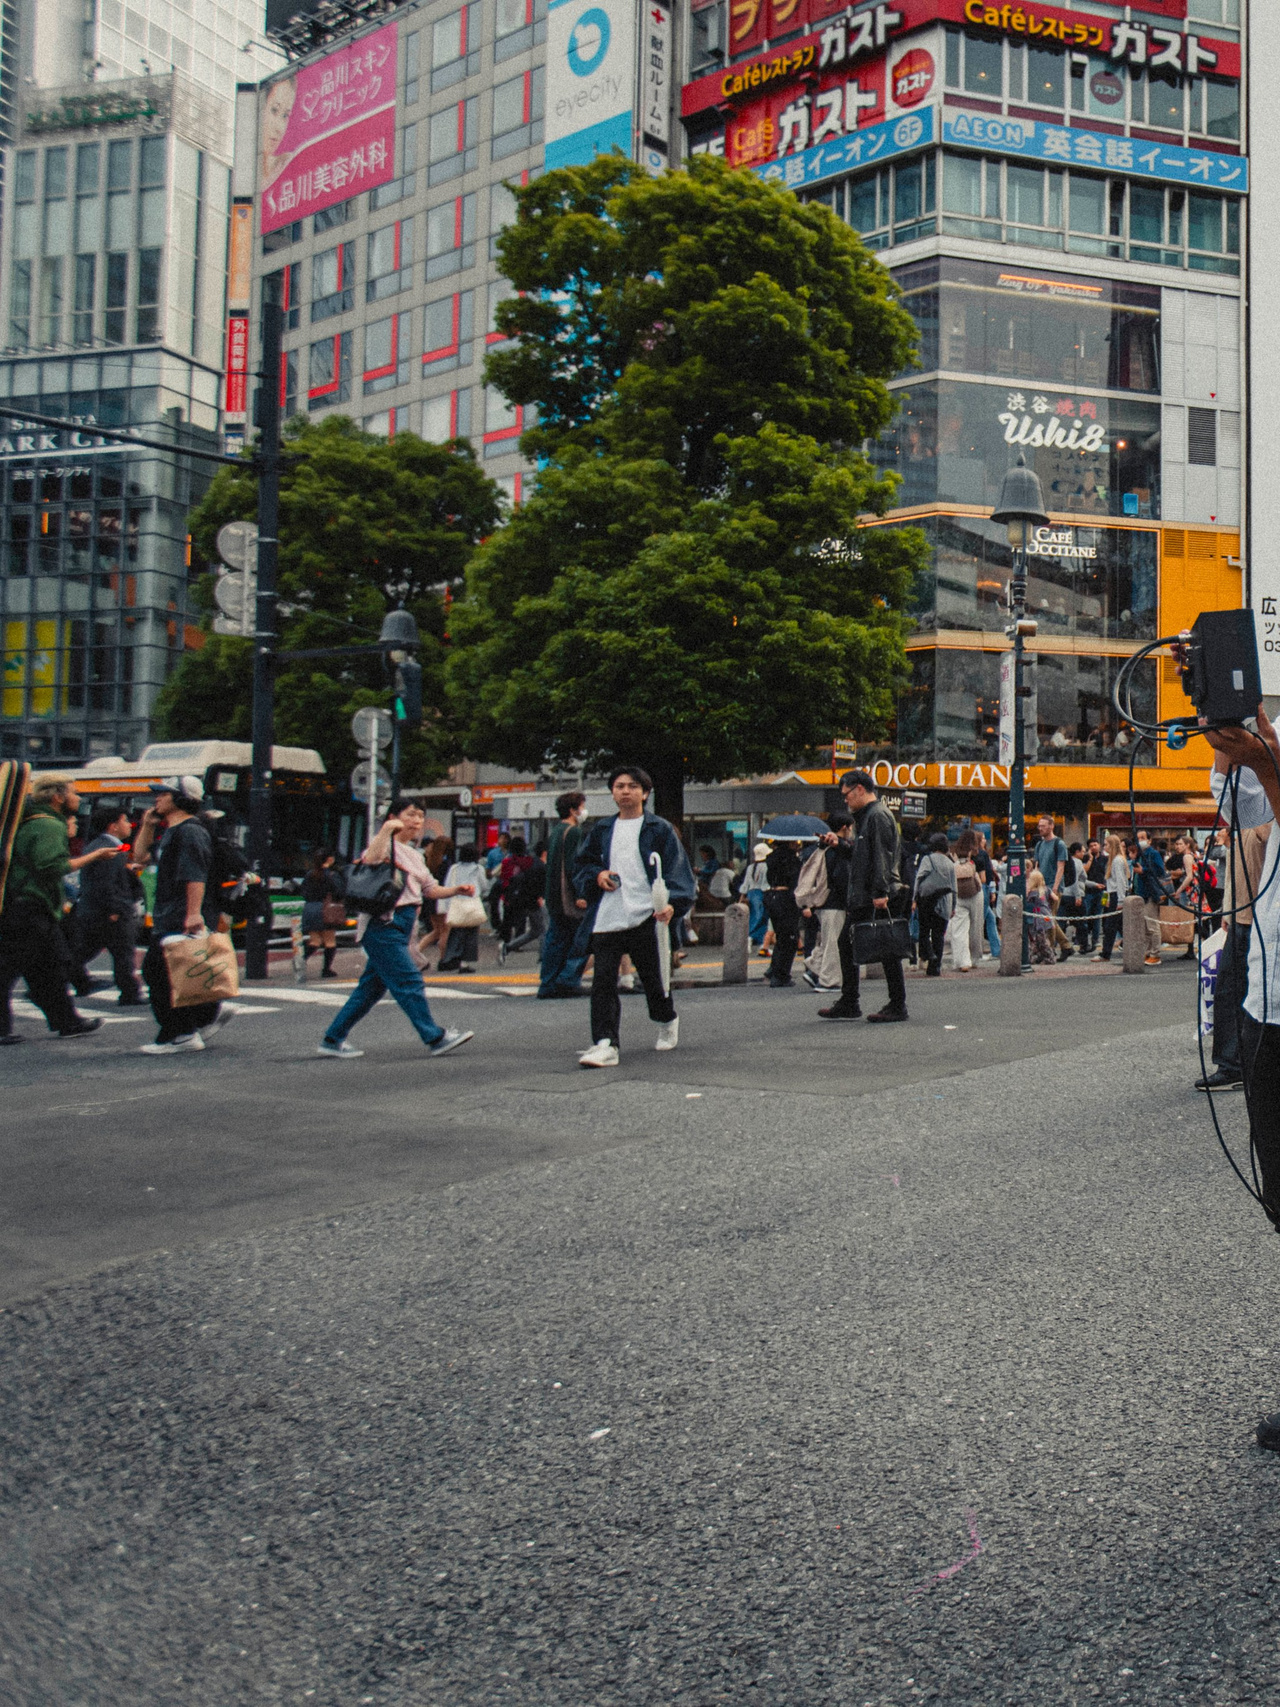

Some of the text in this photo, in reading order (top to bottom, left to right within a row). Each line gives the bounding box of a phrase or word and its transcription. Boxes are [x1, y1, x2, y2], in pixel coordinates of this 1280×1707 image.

[819, 4, 900, 68] ガスト
[1111, 21, 1217, 73] ガスト
[321, 43, 391, 96] 品川スキン
[555, 74, 623, 117] eyecity
[650, 35, 664, 122] 献血ルーム
[896, 72, 931, 97] ガスト
[322, 75, 383, 124] クリニック
[777, 81, 878, 159] ガスト
[732, 118, 774, 151] Café
[955, 117, 1241, 183] AEON 英会話イーオン
[278, 137, 388, 213] 品川美容外科
[1007, 392, 1050, 414] 渋谷
[998, 412, 1106, 452] Ushi8
